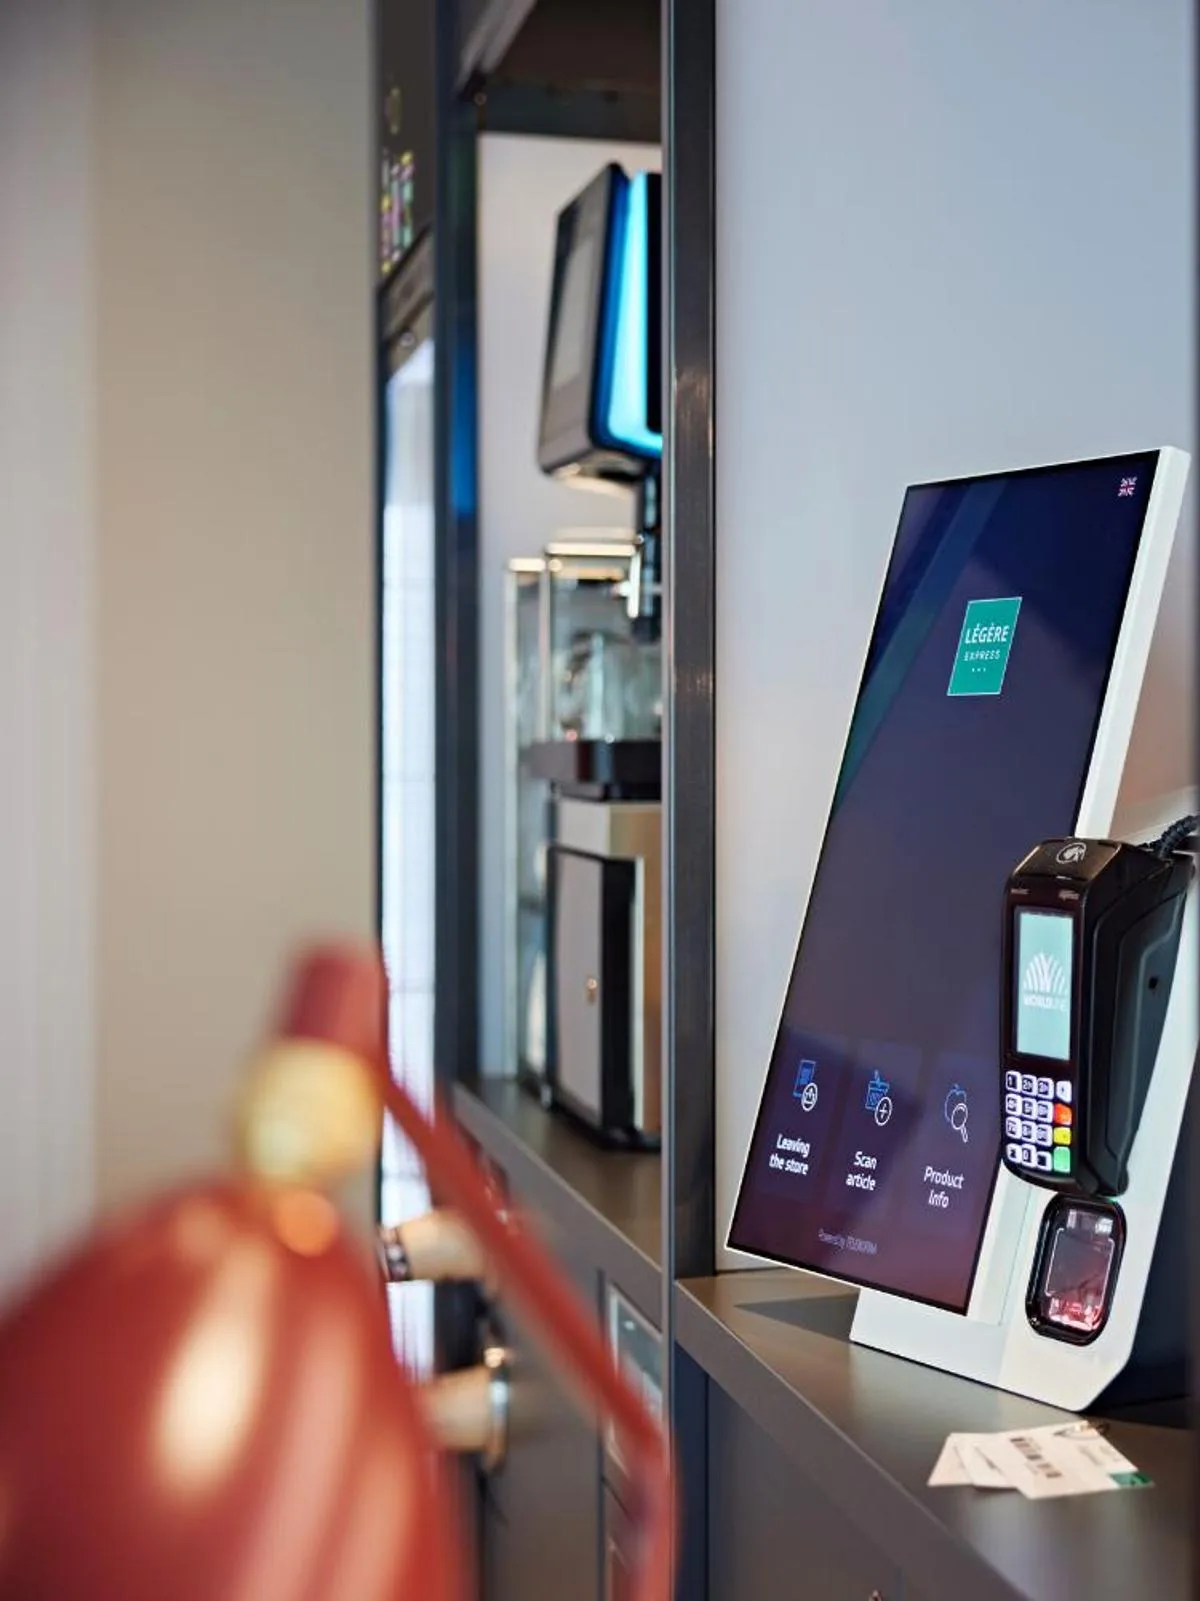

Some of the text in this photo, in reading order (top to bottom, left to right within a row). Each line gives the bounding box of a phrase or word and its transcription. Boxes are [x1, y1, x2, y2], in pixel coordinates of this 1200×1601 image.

[965, 622, 1009, 644] LÉGÈRE
[963, 649, 1001, 661] EXPRESS
[776, 1133, 810, 1158] Leaving
[769, 1153, 808, 1175] the store
[854, 1151, 877, 1170] Scan
[845, 1173, 876, 1191] article
[923, 1165, 964, 1189] Product
